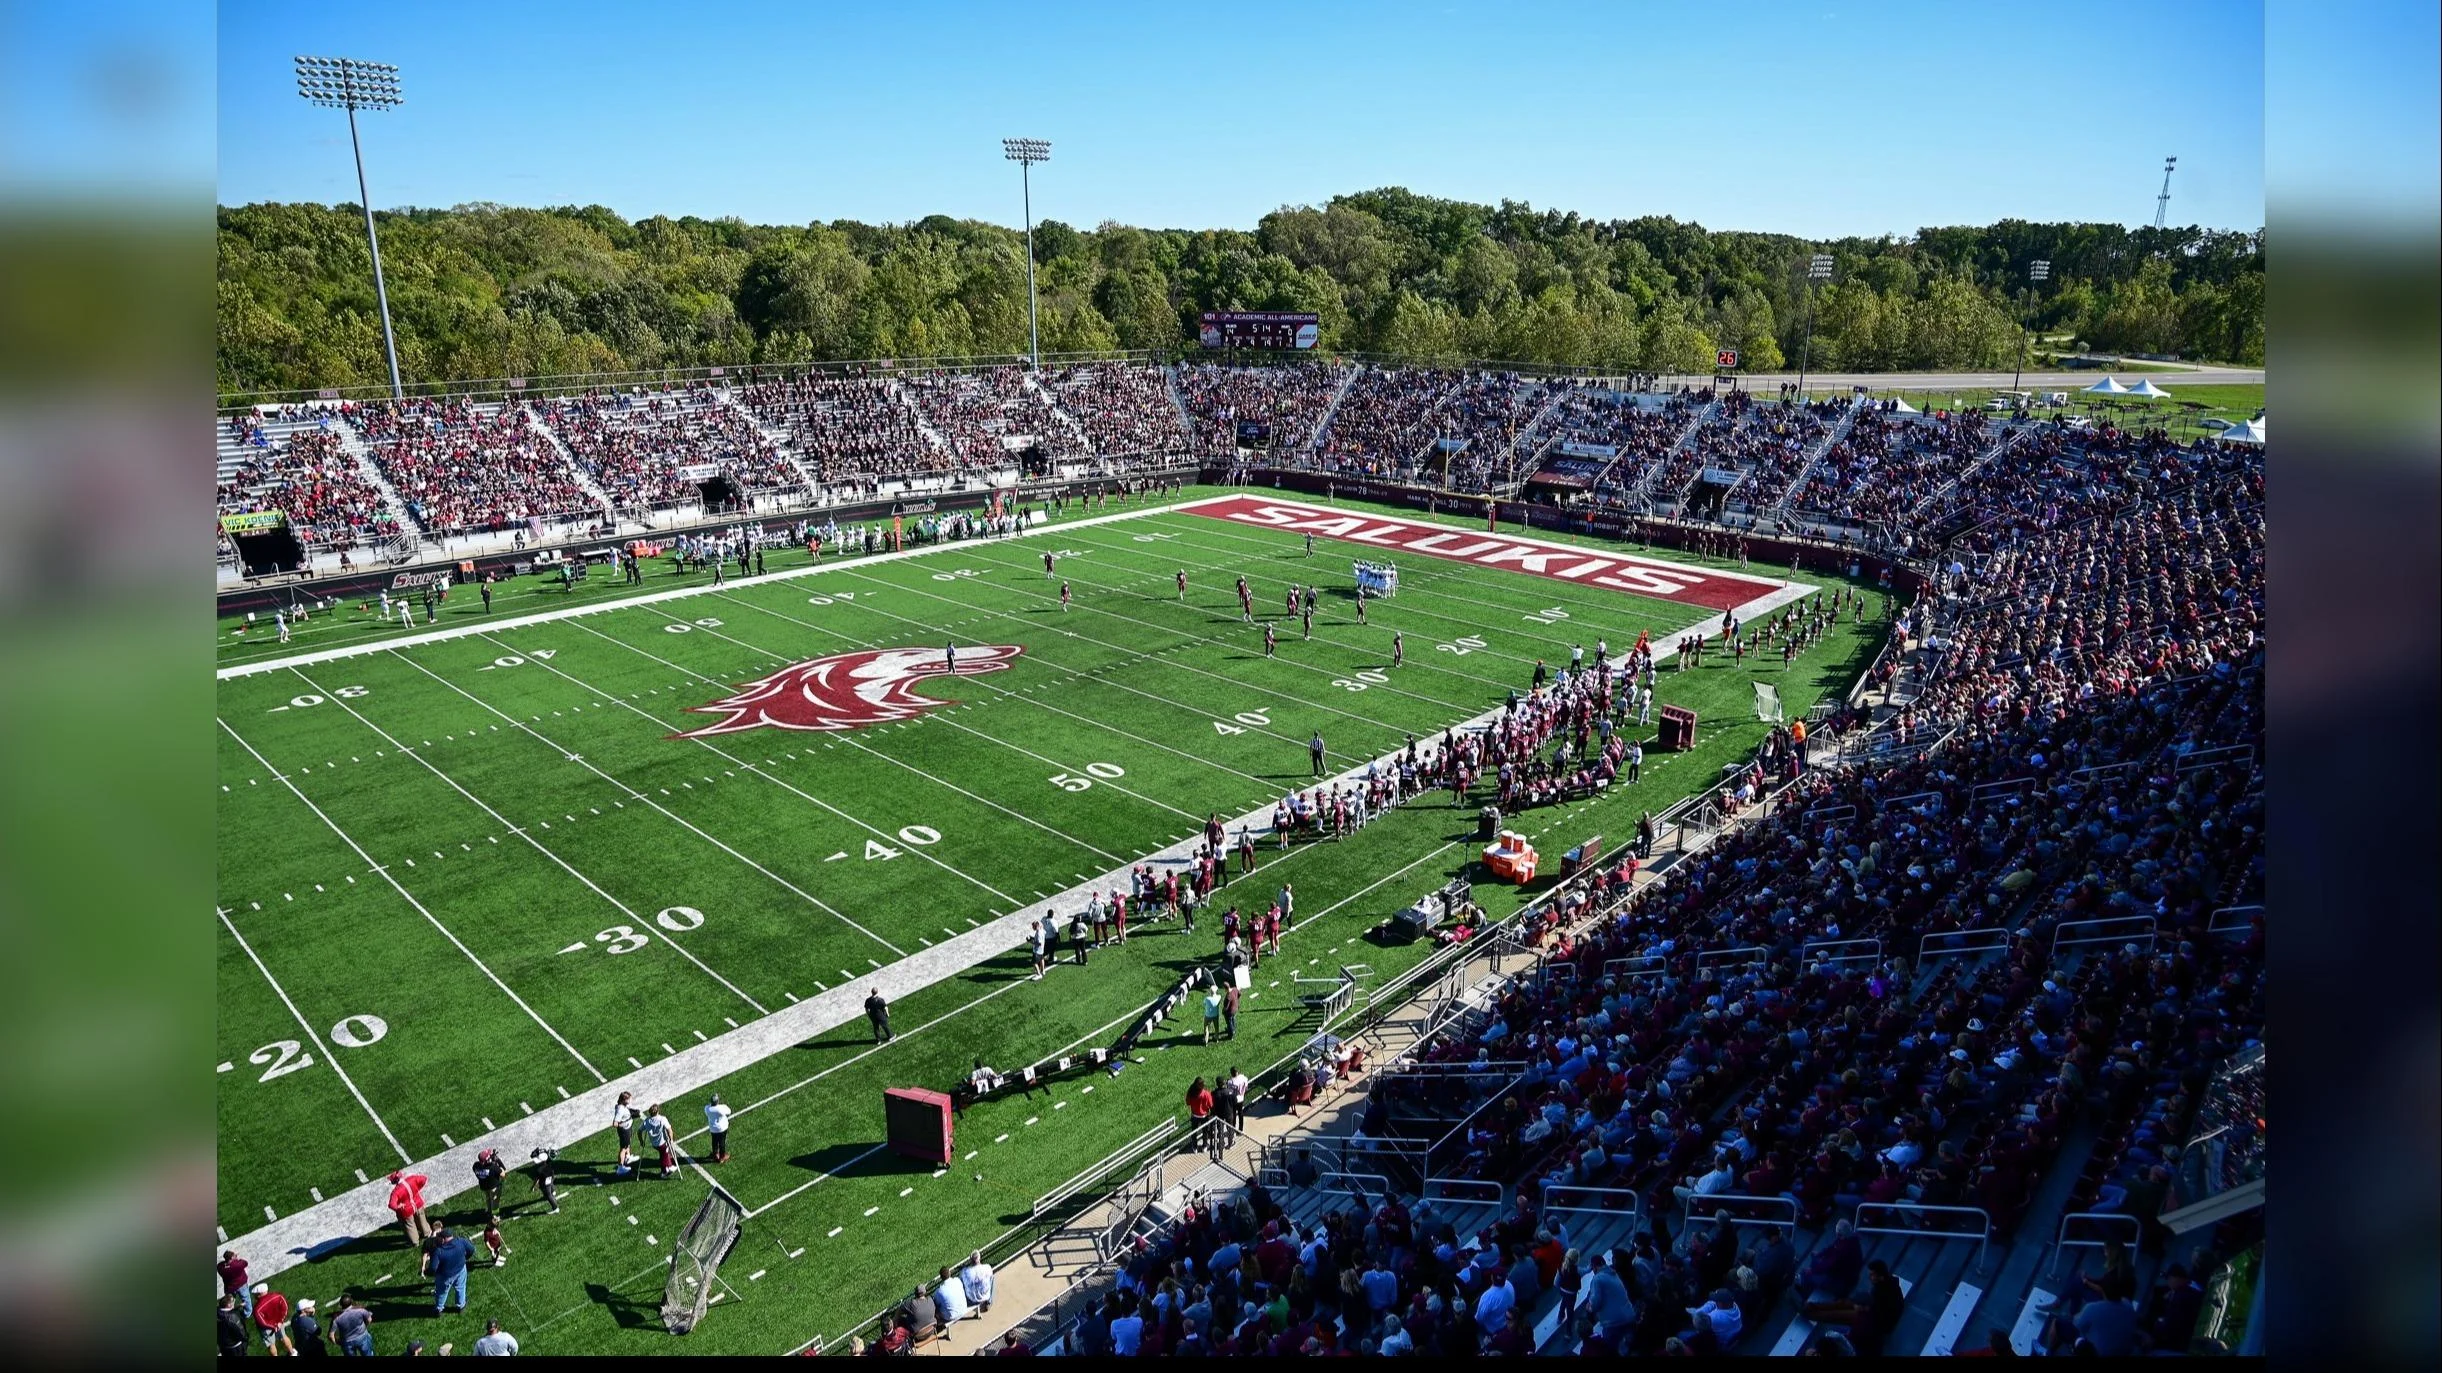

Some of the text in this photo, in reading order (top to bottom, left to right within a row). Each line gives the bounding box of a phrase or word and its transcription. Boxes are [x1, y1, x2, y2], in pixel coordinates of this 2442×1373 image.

[1720, 352, 1734, 364] 26
[1448, 499, 1459, 509] 30
[1227, 506, 1706, 594] SALUKIS
[664, 617, 725, 634] 50
[1522, 608, 1570, 625] 10
[1436, 635, 1488, 656] 20
[1331, 668, 1390, 692] 30
[1213, 711, 1271, 736] 40
[1048, 762, 1126, 792] 50
[864, 825, 943, 862] 40
[594, 906, 705, 955] 30
[249, 1014, 389, 1083] 20
